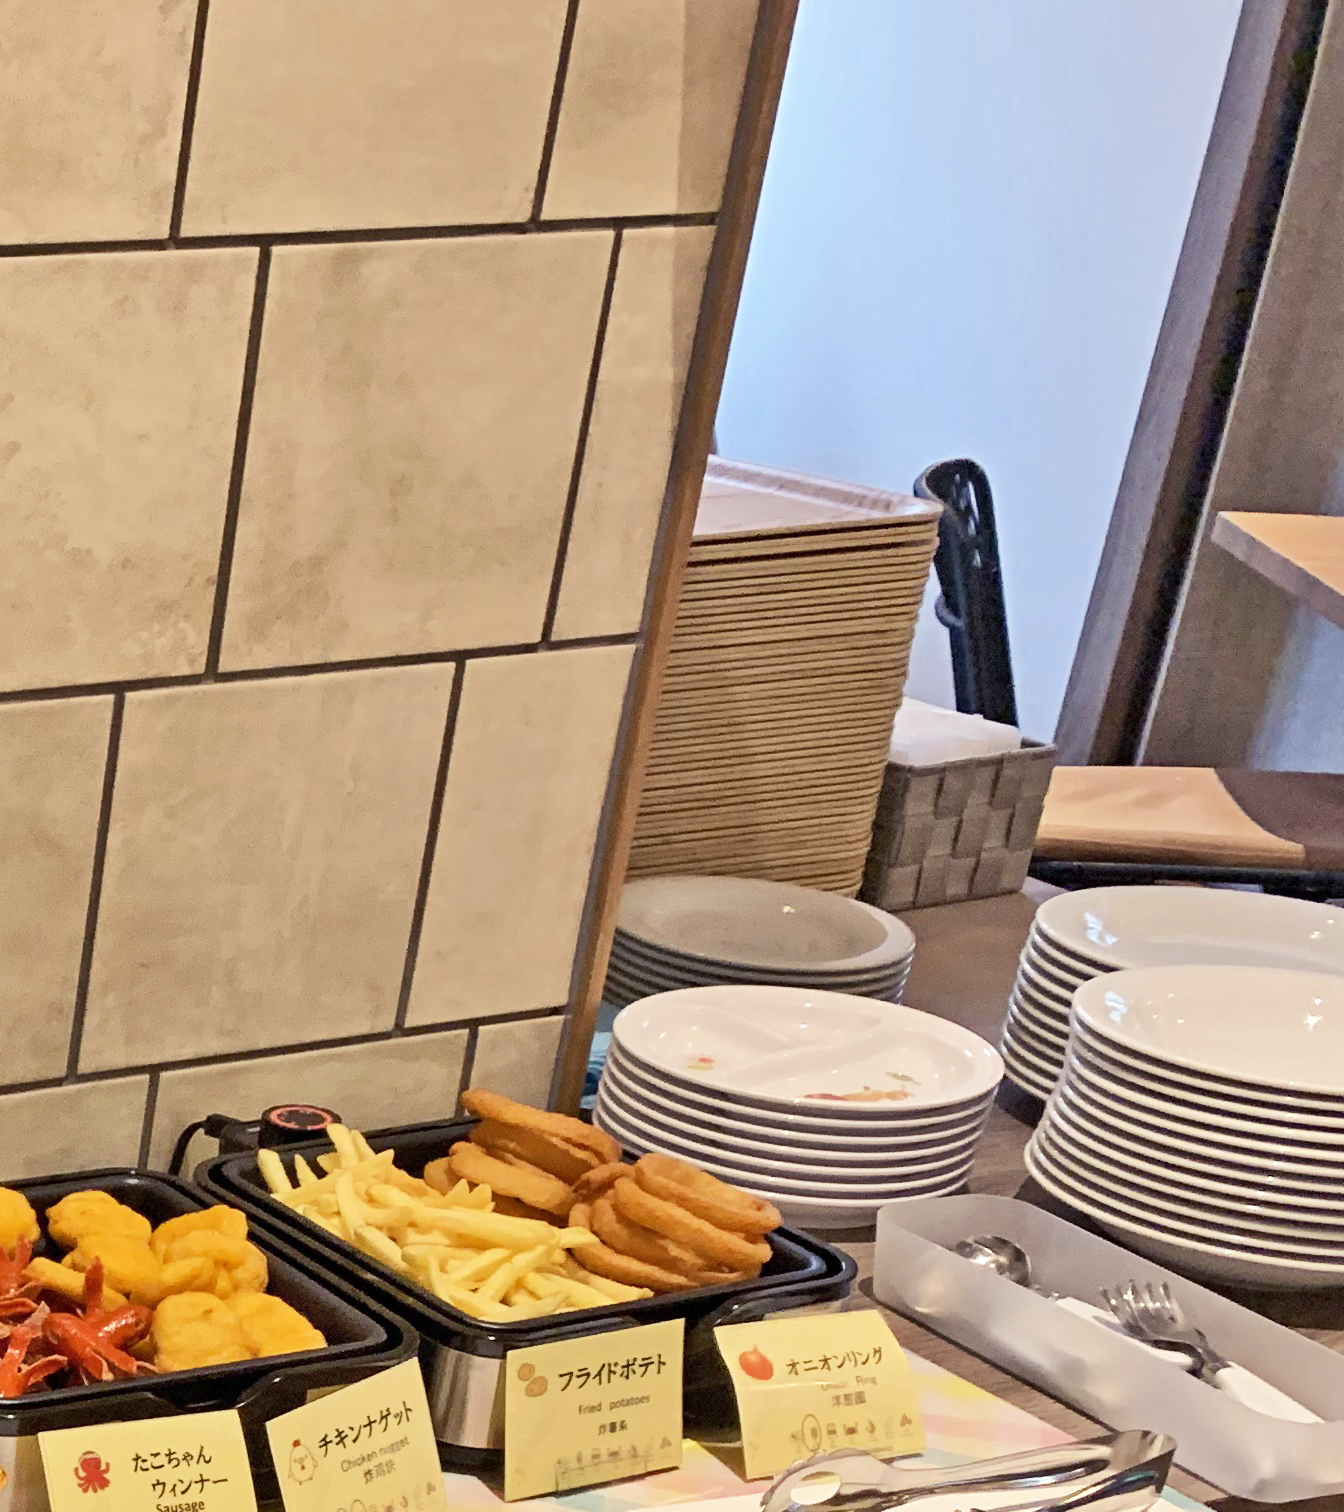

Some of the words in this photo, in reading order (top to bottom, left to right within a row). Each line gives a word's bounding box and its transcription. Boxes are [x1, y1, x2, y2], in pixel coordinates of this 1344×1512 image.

[558, 1353, 667, 1392] フライドポテト
[785, 1346, 883, 1376] オニオンリング
[578, 1401, 602, 1415] Fried
[609, 1395, 651, 1411] potatoes
[318, 1400, 413, 1458] チキンナゲット
[131, 1444, 213, 1473] たこちゃん
[340, 1450, 378, 1473] Chicken
[151, 1473, 229, 1499] ウィンナー
